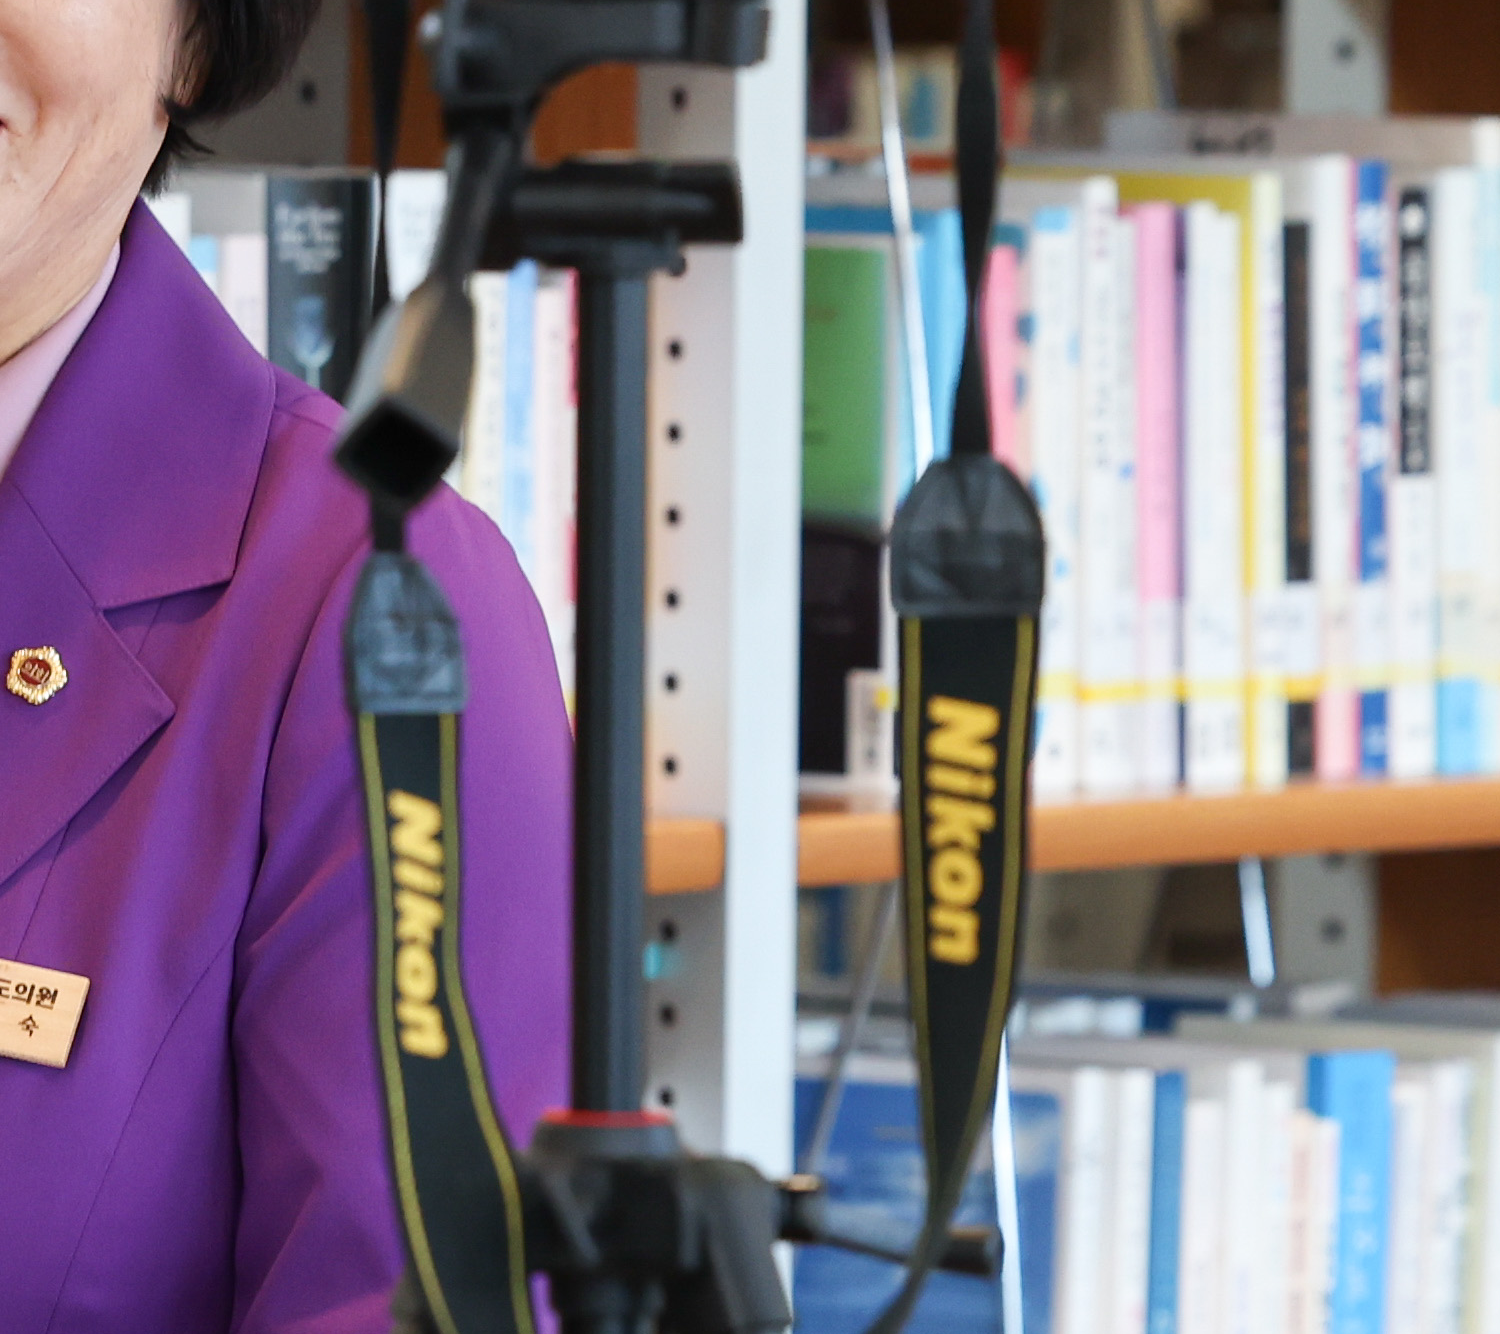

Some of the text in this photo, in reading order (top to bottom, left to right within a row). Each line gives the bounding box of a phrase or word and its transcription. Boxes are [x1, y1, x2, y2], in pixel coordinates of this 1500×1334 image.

[388, 789, 448, 1061] Nikon
[925, 695, 1001, 966] Nikon
[17, 1013, 39, 1038] 숙
